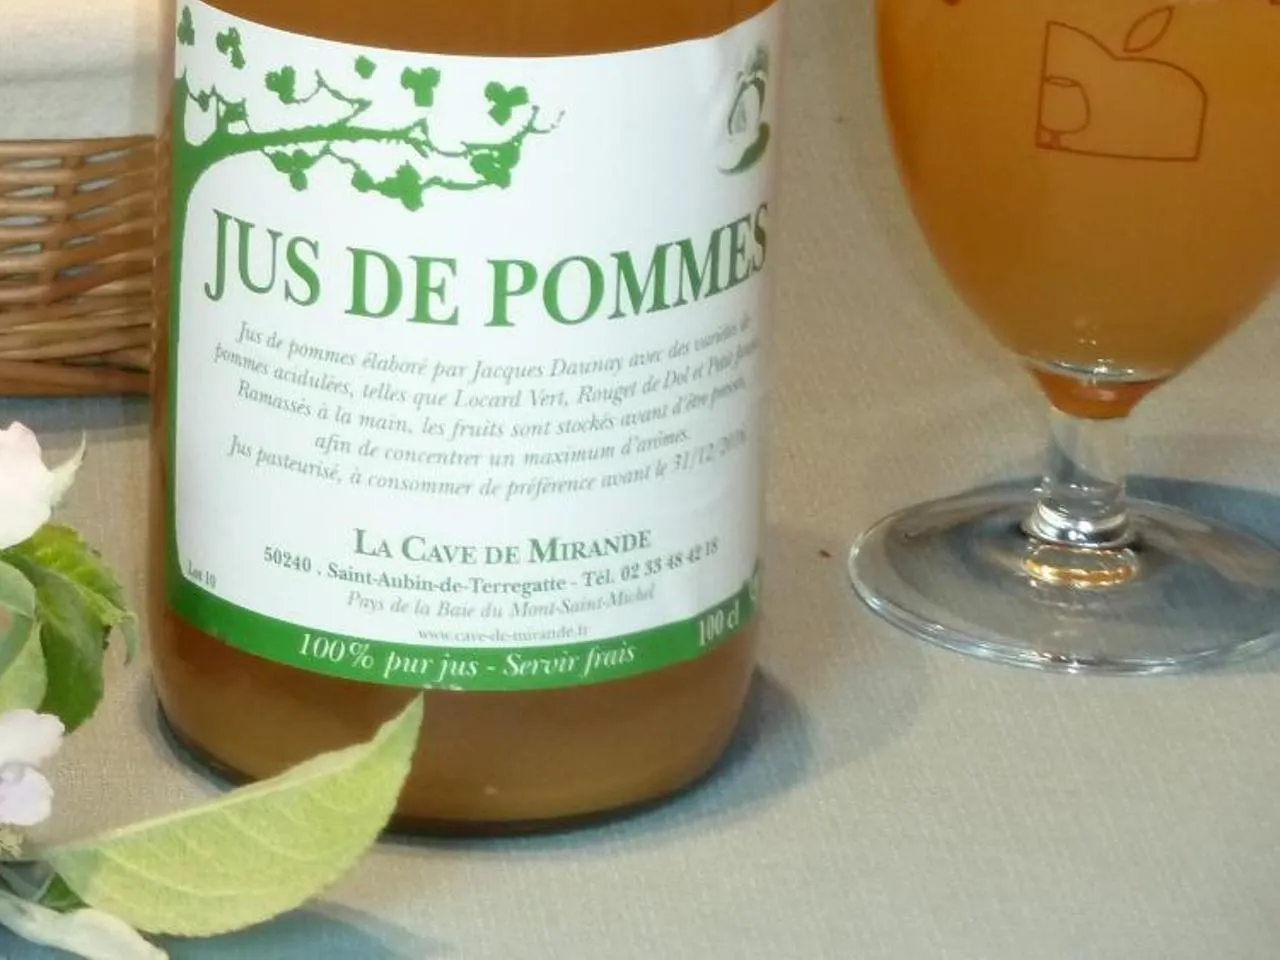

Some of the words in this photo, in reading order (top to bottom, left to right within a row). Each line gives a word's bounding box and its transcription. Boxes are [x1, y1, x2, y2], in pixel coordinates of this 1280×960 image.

[204, 209, 320, 307] JUS
[345, 246, 460, 326] DE
[484, 201, 769, 328] POMMES
[213, 341, 269, 376] pommes
[273, 365, 354, 399] acidulées,
[362, 381, 407, 403] telles
[412, 391, 448, 412] que
[454, 388, 523, 409] Locard
[577, 381, 638, 406] Rouget
[642, 374, 663, 395] de
[662, 365, 690, 390] Dol
[692, 361, 705, 381] et
[235, 320, 263, 344] Jus
[267, 331, 283, 349] de
[287, 339, 358, 367] pommes
[362, 350, 428, 377] élaboré
[431, 360, 468, 384] par
[468, 358, 544, 386] Jacques
[550, 356, 624, 379] Daunay
[629, 349, 665, 368] avec
[668, 340, 691, 360] des
[237, 378, 313, 417] Ramassés
[317, 400, 329, 420] à
[335, 405, 352, 425] la
[422, 416, 446, 436] les
[446, 417, 505, 442] fruits
[510, 420, 552, 438] sont
[555, 411, 616, 436] stockés
[620, 404, 668, 427] avant
[226, 434, 253, 458] Jus
[254, 445, 343, 485] pasteurisé,
[350, 466, 362, 485] à
[367, 473, 472, 496] consommer
[478, 477, 500, 497] de
[504, 474, 597, 502] préférence
[601, 465, 652, 488] avant
[655, 458, 668, 479] le
[314, 433, 352, 456] afin
[357, 438, 379, 458] de
[384, 445, 482, 467] concentrer
[489, 453, 516, 467] un
[524, 444, 617, 466] maximum
[263, 545, 313, 574] 50240
[327, 561, 568, 600] Saint-Aubin-de-Terregatte
[581, 570, 616, 589] Tél.
[620, 563, 641, 582] 02
[643, 555, 663, 577] 33
[347, 589, 384, 615] Pays
[389, 595, 410, 615] de
[414, 598, 431, 617] la
[436, 599, 476, 619] Baie
[480, 601, 504, 619] du
[510, 581, 657, 619] Mont-Saint-Michel
[417, 623, 589, 643] www.cave-de-mirande.fr
[699, 607, 725, 648] 100
[726, 597, 742, 631] cl
[298, 632, 376, 669] 100%
[382, 650, 434, 680] pur
[436, 651, 480, 684] jus
[502, 649, 580, 678] Servir
[582, 640, 639, 679] frais
